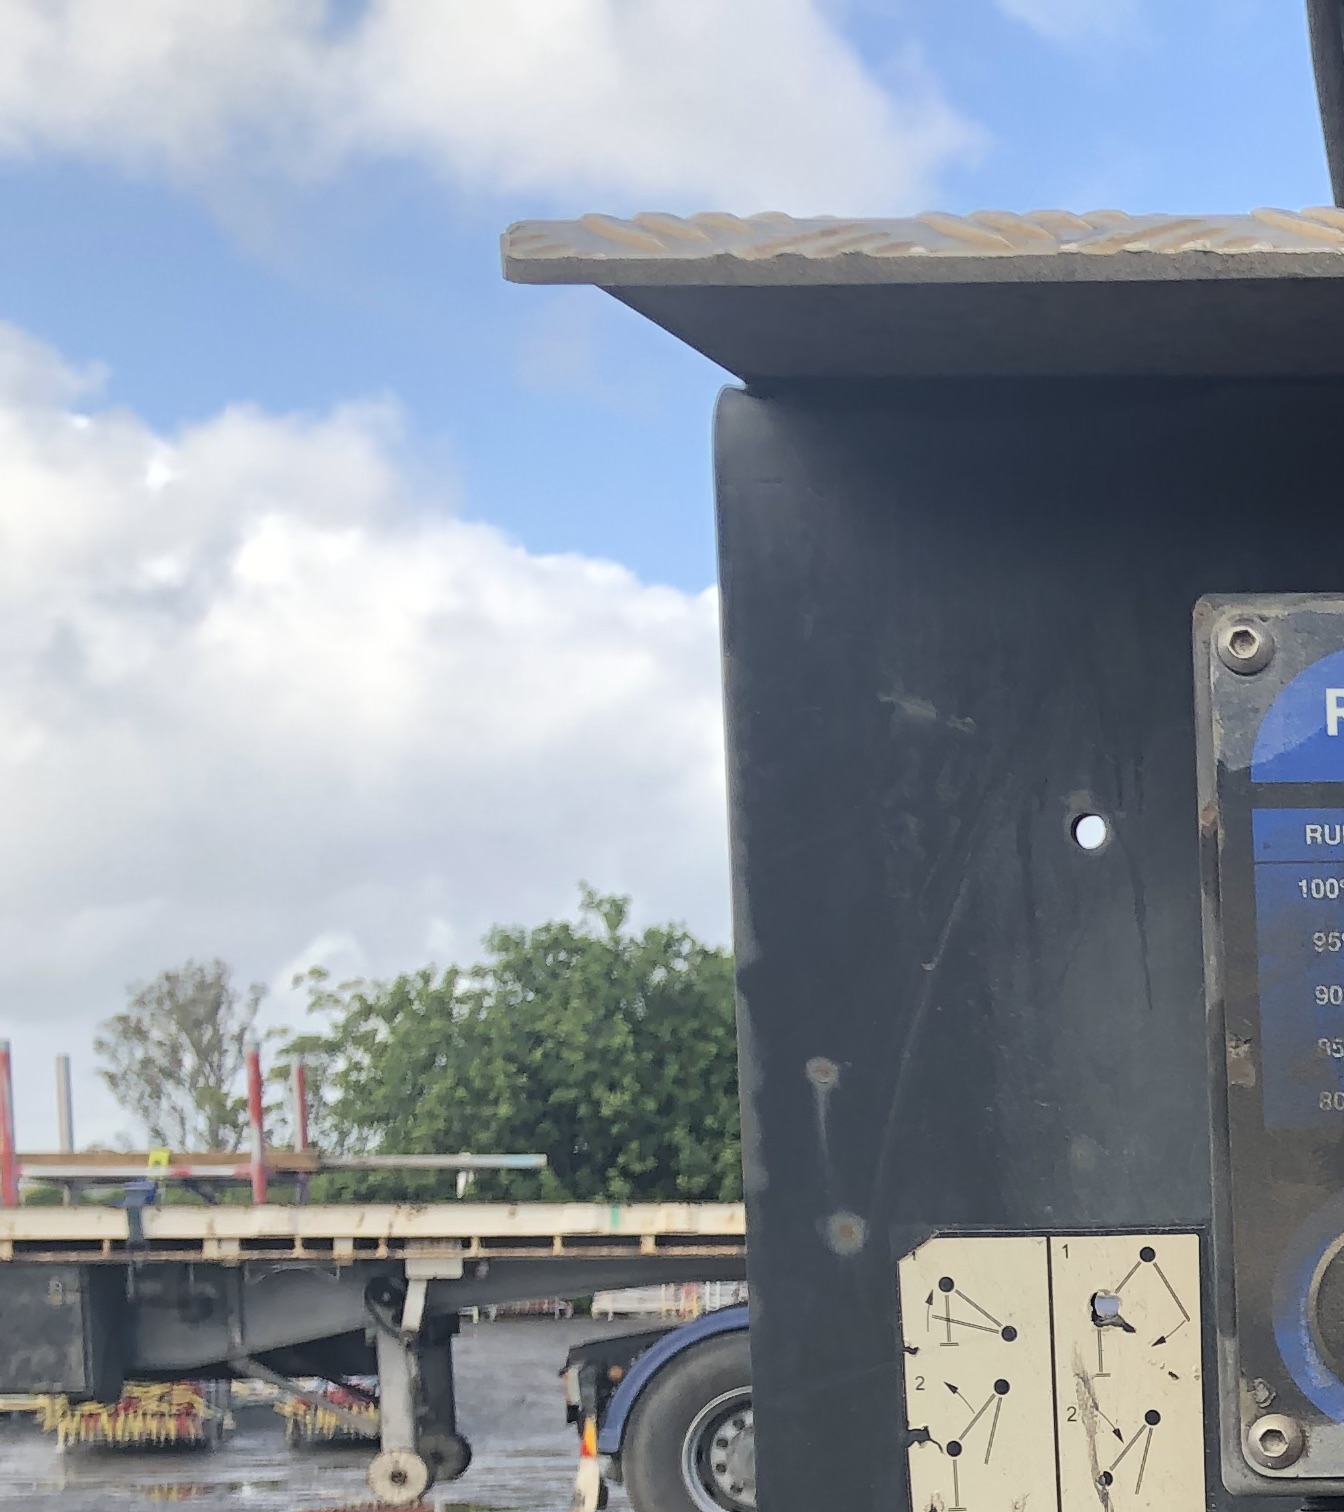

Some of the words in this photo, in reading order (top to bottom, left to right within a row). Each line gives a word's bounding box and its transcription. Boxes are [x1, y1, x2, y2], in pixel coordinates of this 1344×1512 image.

[1062, 1243, 1070, 1260] 1
[914, 1375, 926, 1392] 2
[1066, 1406, 1078, 1423] 2
